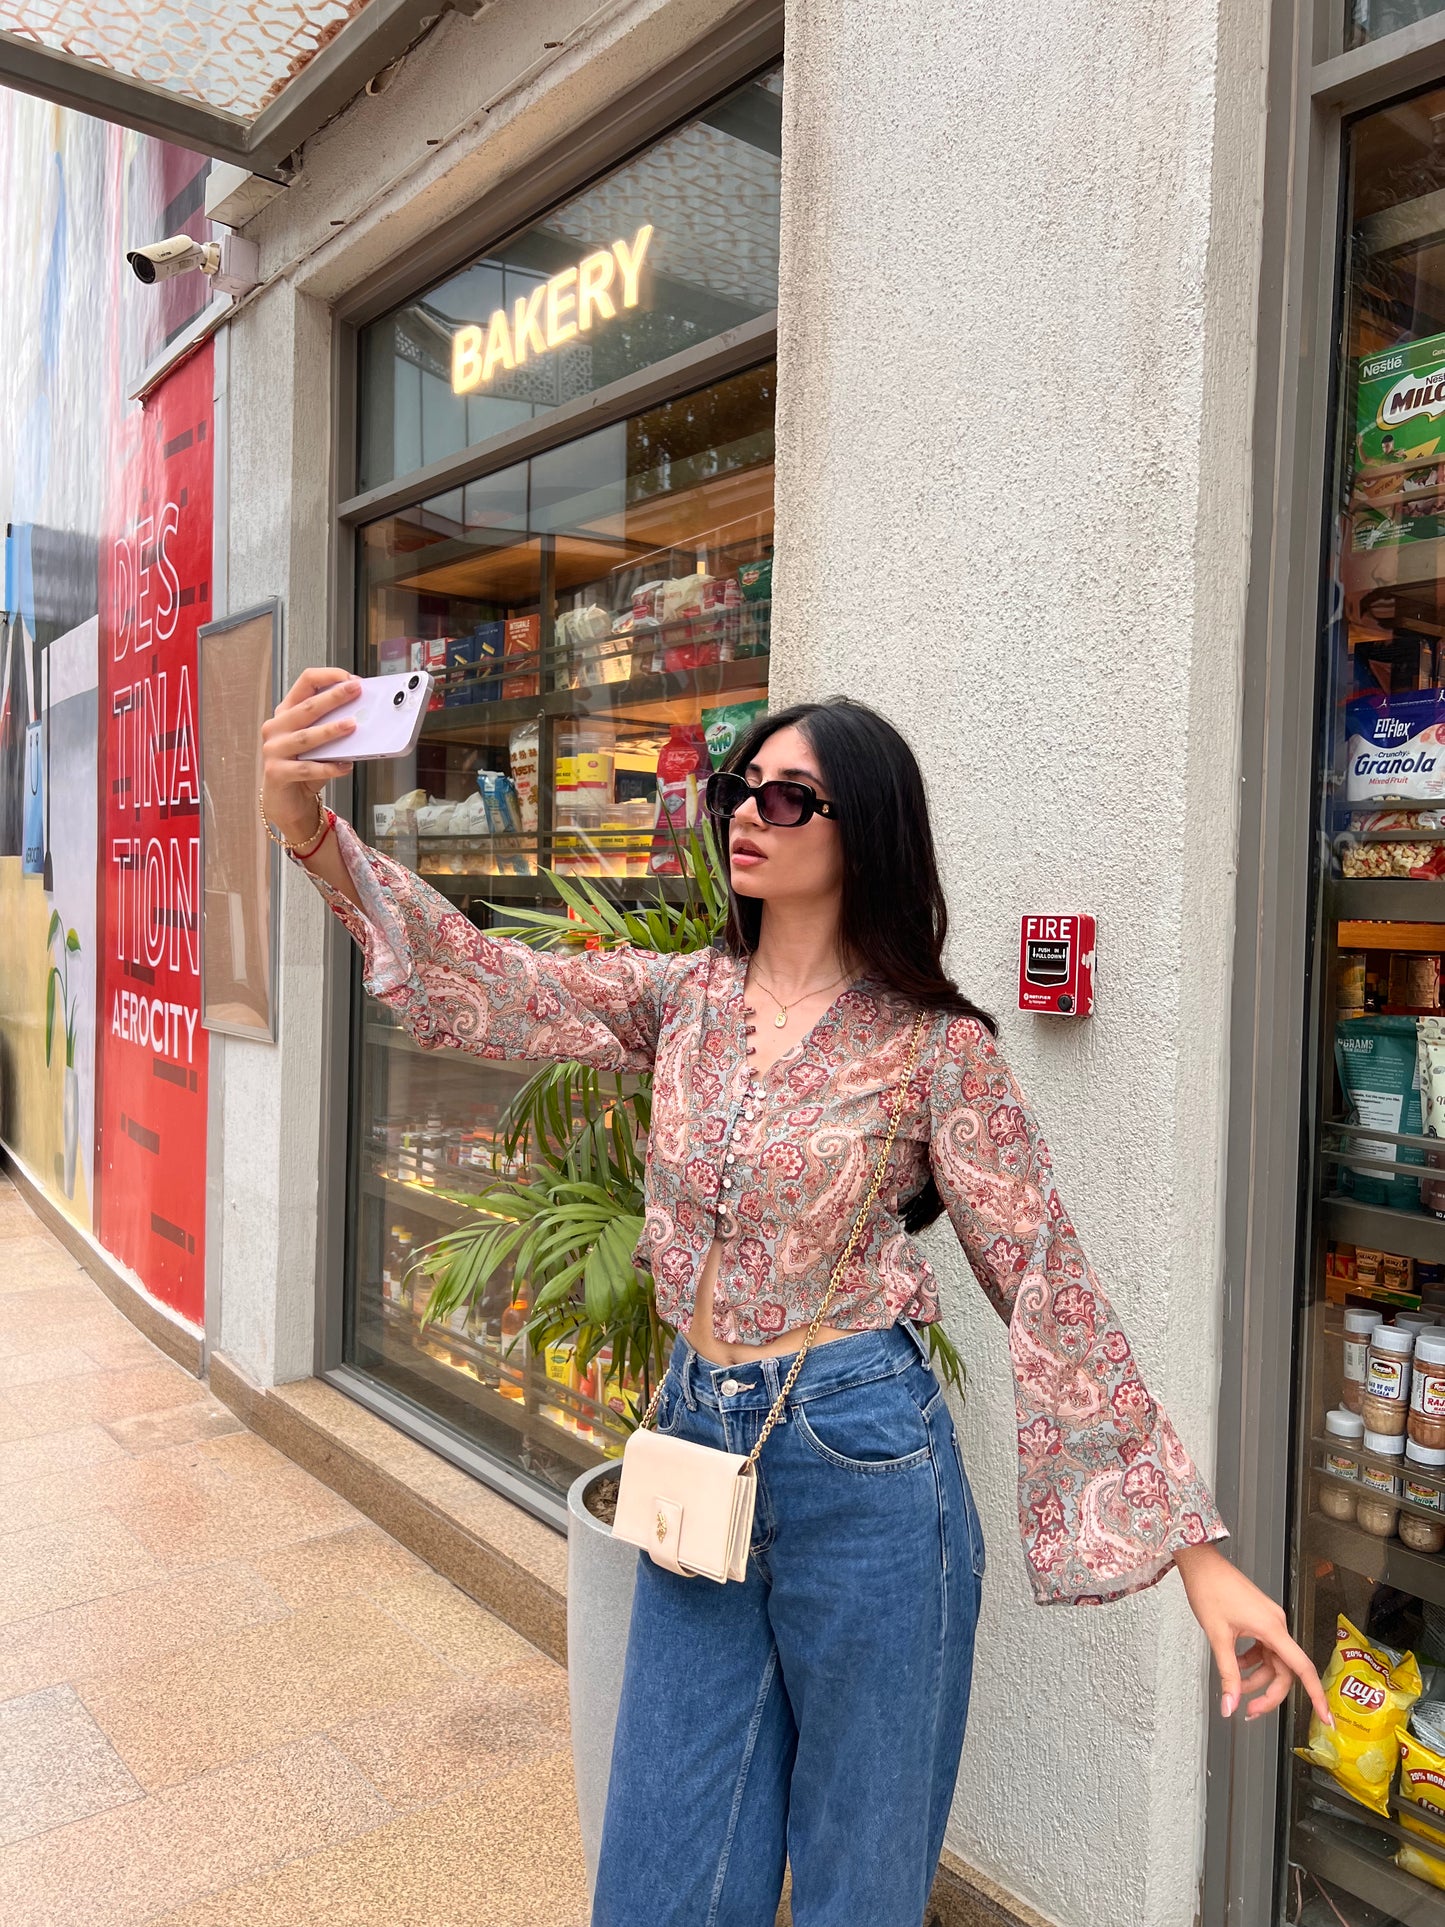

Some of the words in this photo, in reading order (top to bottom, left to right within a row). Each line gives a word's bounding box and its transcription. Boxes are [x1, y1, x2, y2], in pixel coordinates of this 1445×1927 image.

[452, 224, 655, 395] BAKERY
[112, 502, 181, 663] DES
[112, 665, 200, 811] TINA
[1354, 752, 1436, 776] Granola
[1390, 776, 1408, 784] Fruit
[112, 837, 200, 976] TION
[1026, 918, 1072, 939] FIRE
[111, 988, 198, 1064] AEROCITY
[1427, 1398, 1445, 1407] RAJ
[1345, 1650, 1363, 1658] 20%
[1363, 1652, 1382, 1671] MORE
[1341, 1676, 1384, 1706] Lay's
[1352, 1721, 1371, 1734] Salted
[1410, 1772, 1426, 1781] 20%
